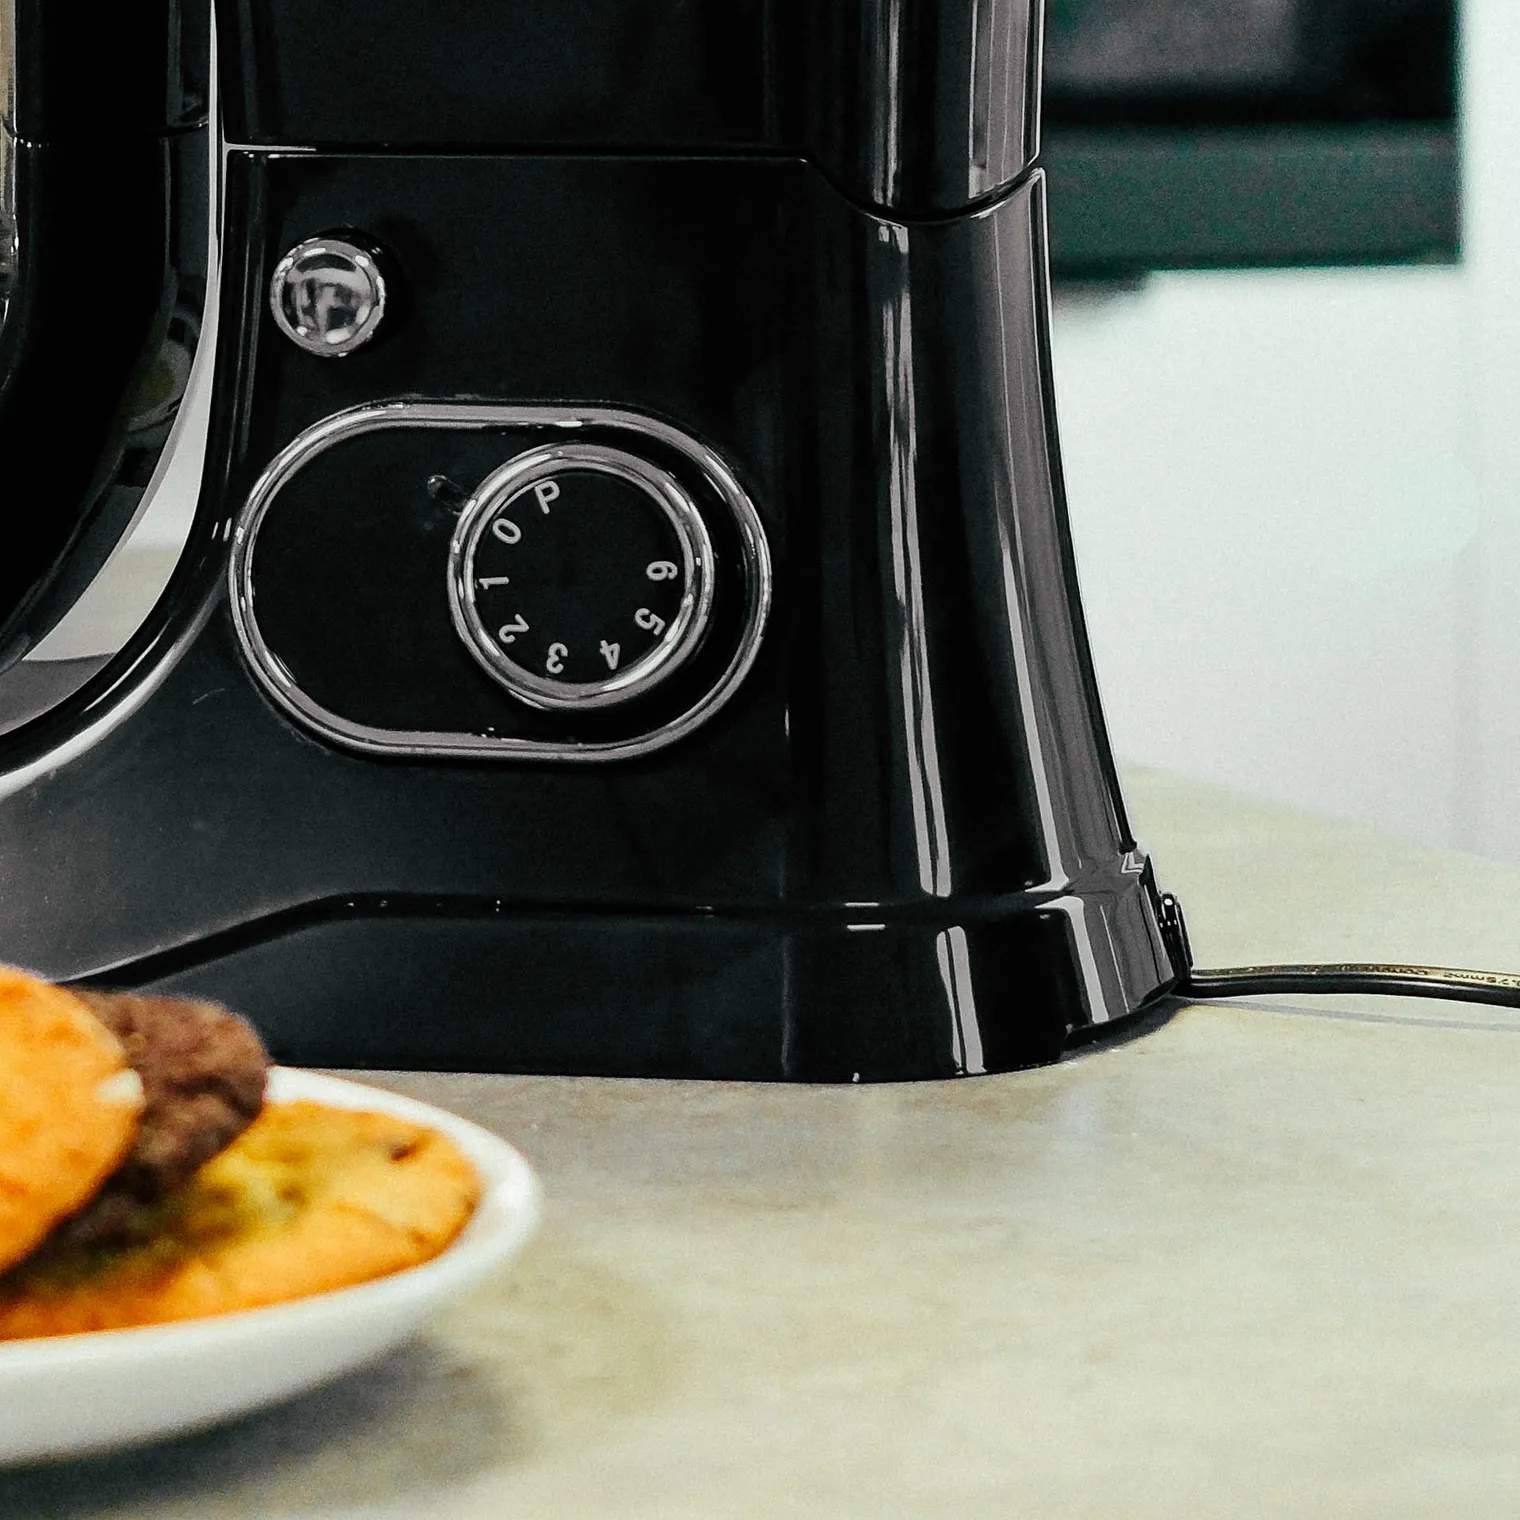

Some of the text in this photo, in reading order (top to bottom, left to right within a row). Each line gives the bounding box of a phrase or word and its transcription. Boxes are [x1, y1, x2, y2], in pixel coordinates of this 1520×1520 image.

[479, 480, 678, 674] P 0 1 2 3 4 5 6
